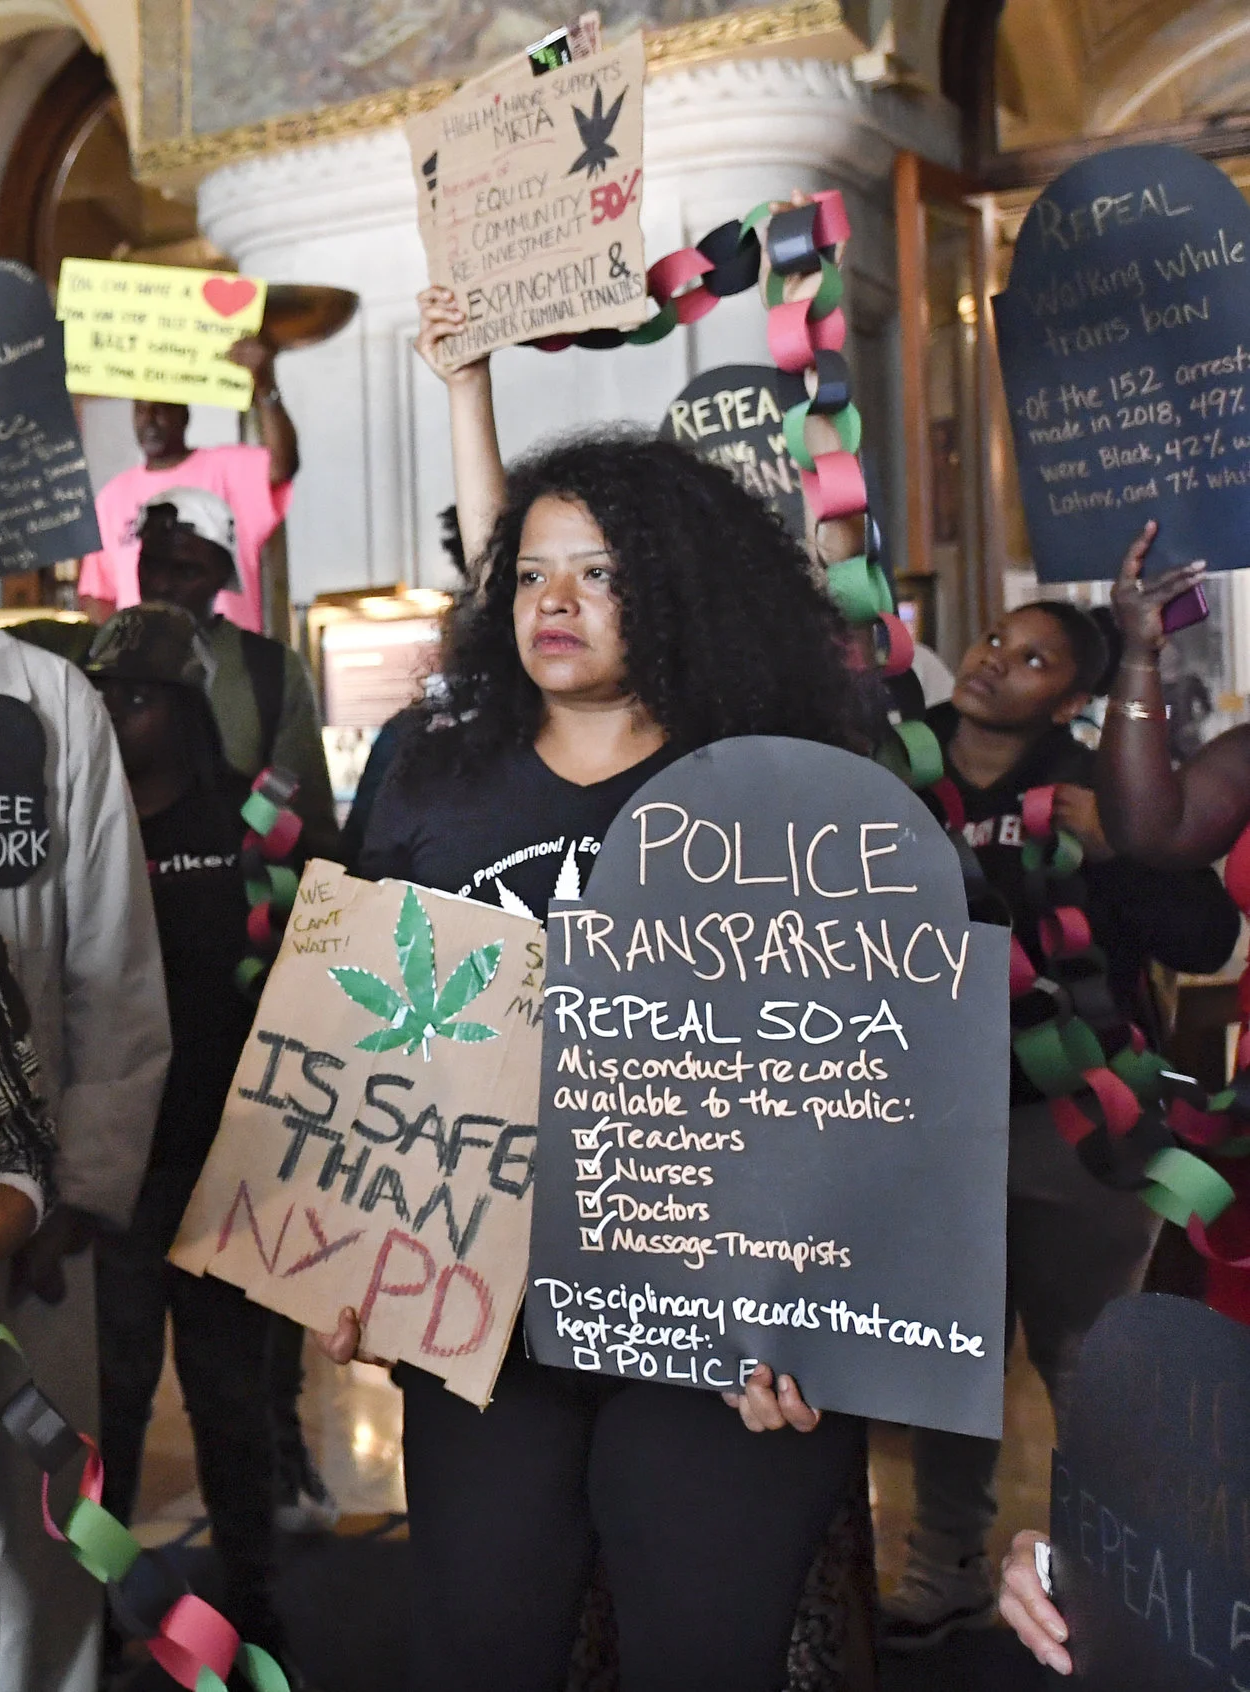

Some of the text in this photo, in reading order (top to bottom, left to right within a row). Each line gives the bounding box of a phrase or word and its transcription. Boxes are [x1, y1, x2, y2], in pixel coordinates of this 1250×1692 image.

[472, 189, 585, 251] COMMUNITY
[590, 168, 642, 226] 50%
[474, 172, 548, 218] EQUITY
[1037, 183, 1193, 250] REPEAL
[467, 241, 630, 321] EXPUNGMENT &
[1059, 383, 1103, 414] the
[1110, 365, 1164, 400] 152
[1176, 344, 1250, 386] arrest
[670, 386, 784, 442] REPEA
[1029, 386, 1245, 445] made in 2018, 49%
[1040, 460, 1091, 483] were
[1098, 442, 1162, 470] Black,
[1165, 428, 1225, 461] 42%
[1122, 478, 1159, 501] and
[1165, 467, 1199, 493] 7%
[473, 836, 565, 888] PROHIBITION!
[632, 801, 918, 898] POLICE
[300, 879, 335, 904] WE
[292, 935, 350, 954] WAIT!
[548, 908, 970, 1000] TRANSPARENCY
[543, 984, 742, 1045] REPEAL
[756, 998, 910, 1051] 50-A
[557, 1044, 888, 1085] Misconduct records
[238, 1030, 538, 1201] IS SAFE
[554, 1082, 915, 1131] available to the public:
[602, 1121, 745, 1152] Teachers
[277, 1114, 492, 1262] THAN
[615, 1157, 714, 1187] Nurses
[607, 1193, 710, 1222] Doctors
[611, 1227, 851, 1273] Massage Therapists
[534, 1278, 985, 1358] Disciplinary records that can be
[556, 1311, 713, 1350] kept secret:
[1056, 1465, 1214, 1669] REPEAL
